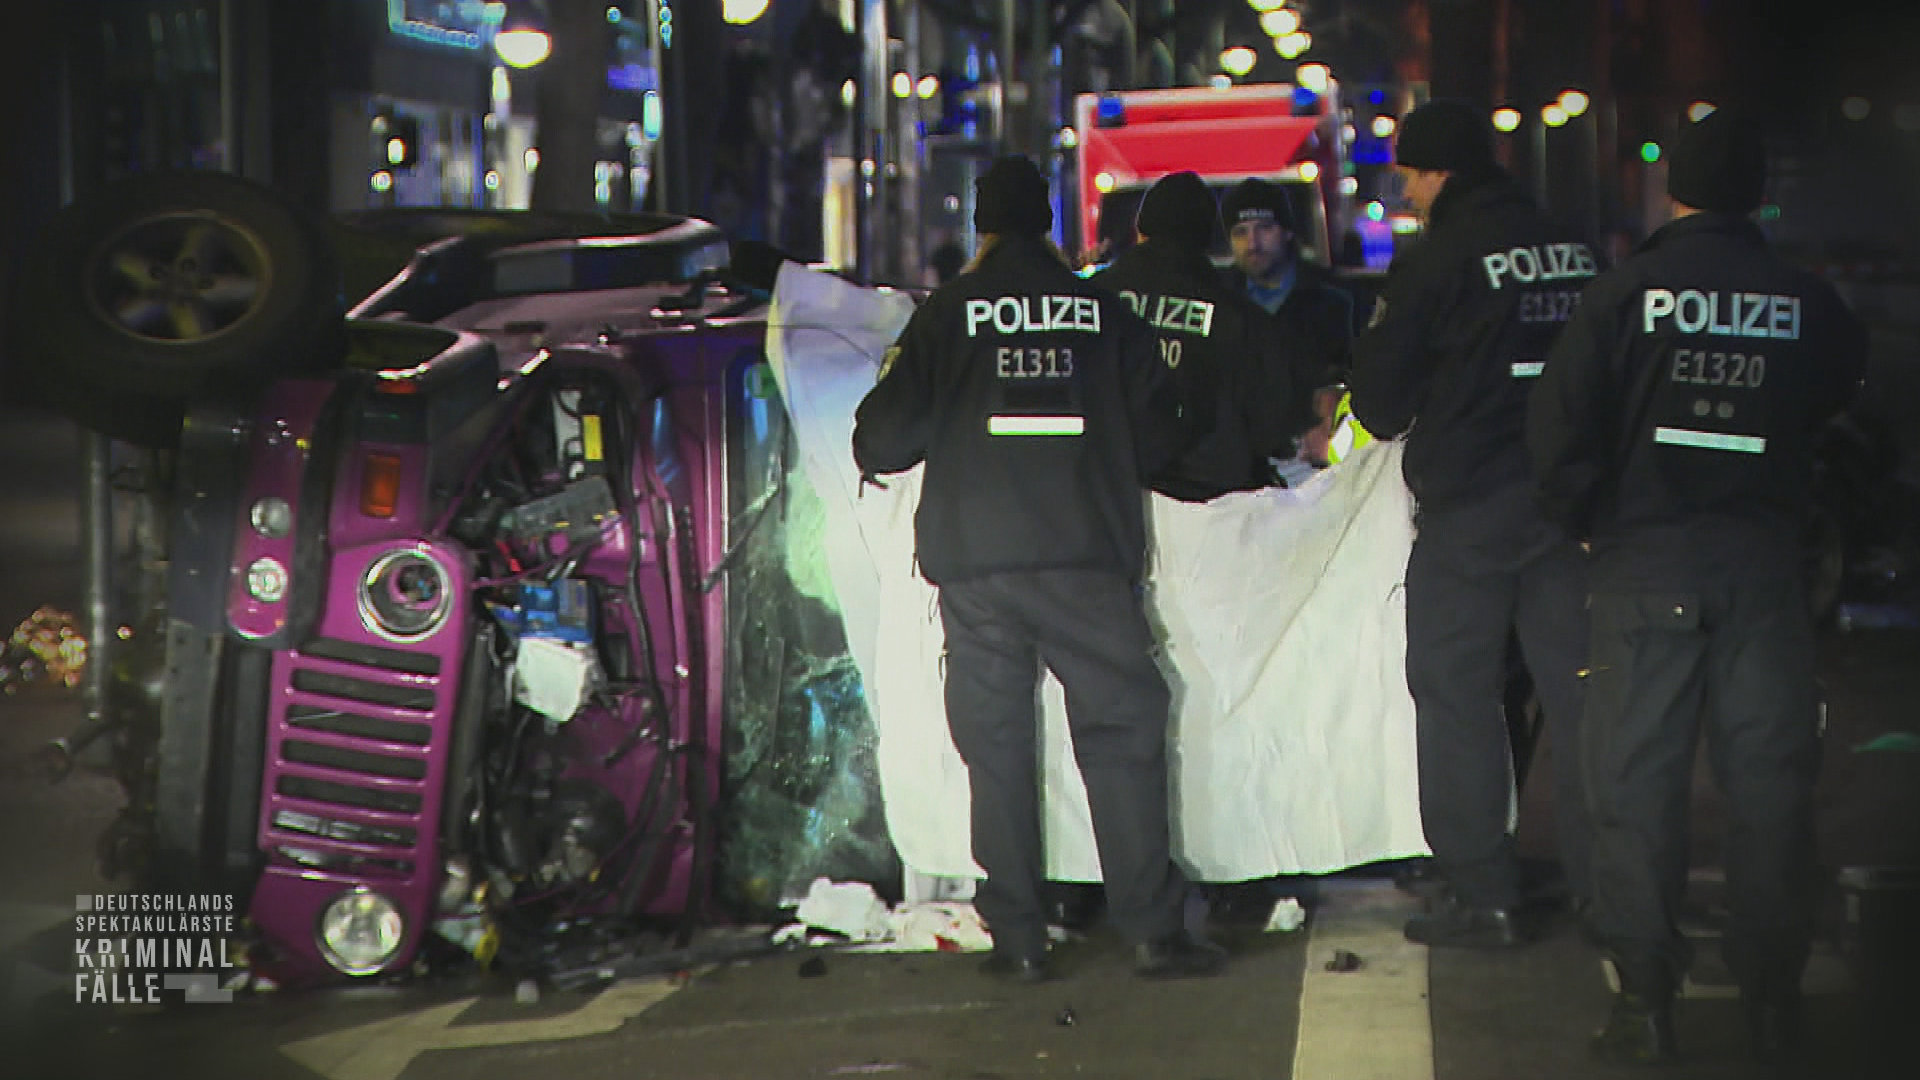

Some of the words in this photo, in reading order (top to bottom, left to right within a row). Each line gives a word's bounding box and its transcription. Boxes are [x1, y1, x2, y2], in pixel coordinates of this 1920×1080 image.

[966, 294, 1101, 337] POLIZEI
[1643, 288, 1801, 340] POLIZEI
[996, 346, 1074, 378] E1313
[1671, 349, 1766, 388] E1320
